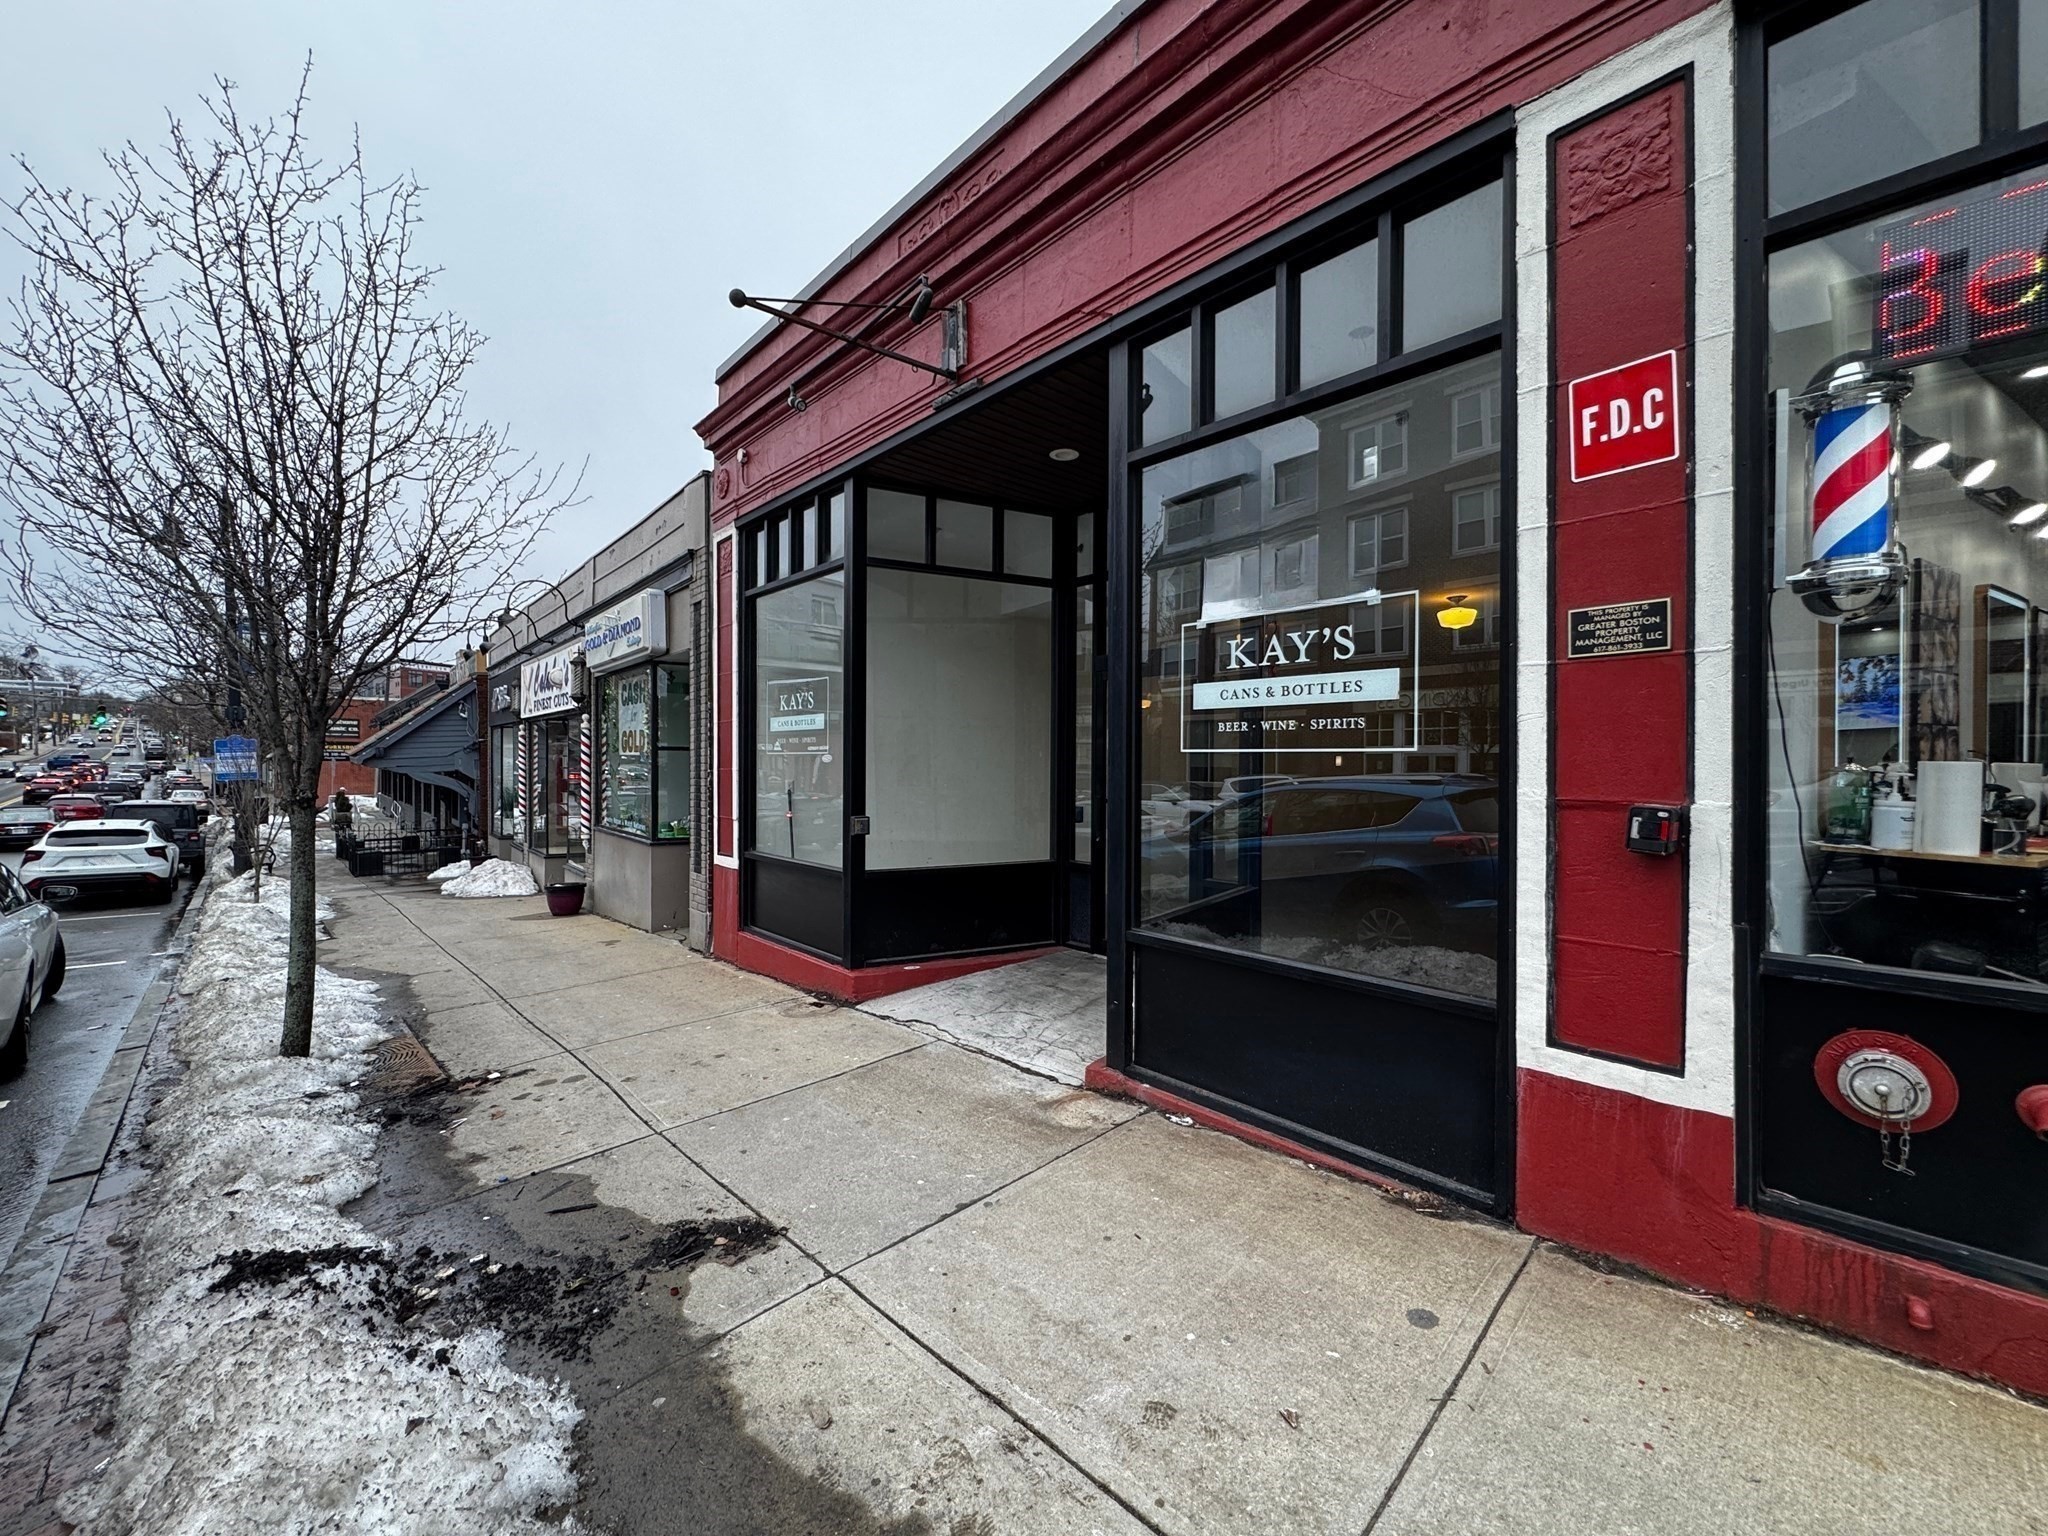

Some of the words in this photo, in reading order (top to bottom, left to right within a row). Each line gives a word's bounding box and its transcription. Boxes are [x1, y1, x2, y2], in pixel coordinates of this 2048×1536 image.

[1880, 240, 2047, 339] Be
[1581, 387, 1665, 447] F.D.C
[1593, 613, 1630, 621] MANAGED
[1605, 605, 1639, 613] PROPERTY
[609, 616, 641, 642] DIAMOND
[1577, 621, 1616, 631] GREATER
[1619, 616, 1660, 627] BOSTON
[1595, 626, 1640, 637] PROPERTY
[1226, 624, 1356, 670] KAY'S
[1575, 633, 1643, 646] MANAGEMENT,
[1646, 631, 1663, 640] LLC
[621, 680, 646, 706] CASH
[1219, 686, 1260, 701] CANS
[1266, 686, 1276, 698] &
[1281, 680, 1363, 697] BOTTLES
[533, 696, 552, 712] FINEST
[553, 692, 569, 708] CUTS
[780, 691, 814, 711] KAY'S
[1217, 721, 1249, 732] BEER
[1262, 719, 1296, 731] WINE
[1310, 717, 1366, 730] SPIRITS
[621, 729, 646, 753] GOLD
[1826, 1034, 1861, 1057] AUTO
